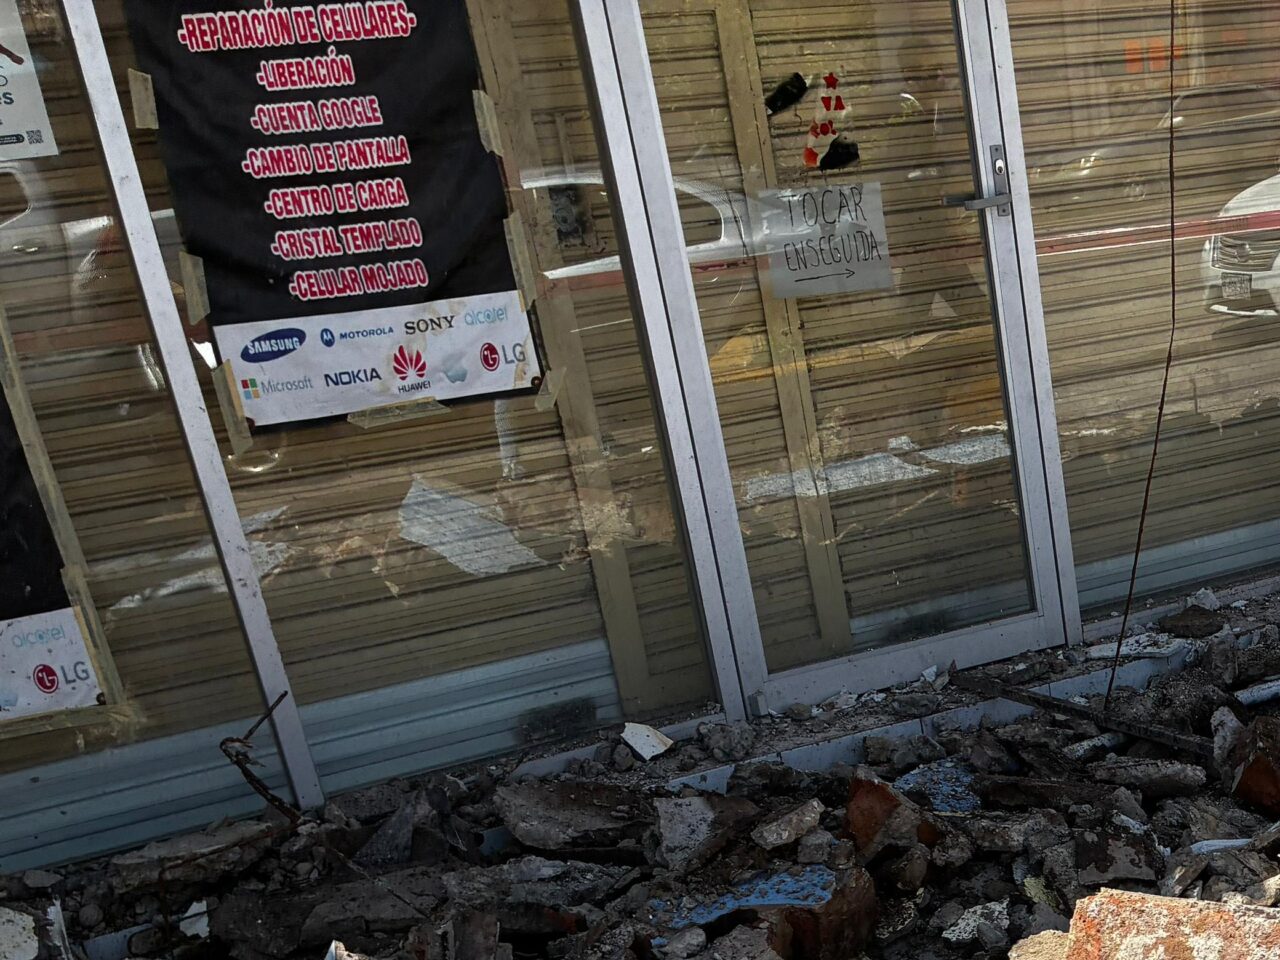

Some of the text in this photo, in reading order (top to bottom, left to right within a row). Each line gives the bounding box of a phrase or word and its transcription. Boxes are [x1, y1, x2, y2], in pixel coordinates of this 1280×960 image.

[292, 6, 319, 44] DE
[318, 95, 383, 129] GOOGLE
[310, 143, 337, 173] DE
[333, 135, 411, 170] PANTALLA
[332, 183, 357, 214] DE
[355, 177, 409, 211] CARGA
[777, 186, 868, 228] TOCAR
[340, 217, 422, 254] TEMPLADO
[783, 230, 882, 272] ENSEGUIDA
[360, 258, 429, 295] MOJADO
[339, 326, 394, 341] MOTOROLA
[404, 315, 456, 336] SONY
[247, 335, 301, 356] SAMSUNG
[502, 343, 527, 365] LG
[260, 377, 314, 394] Microsoft
[323, 367, 383, 388] NOKIA
[397, 381, 432, 395] HUAWEI
[60, 661, 90, 685] LG
